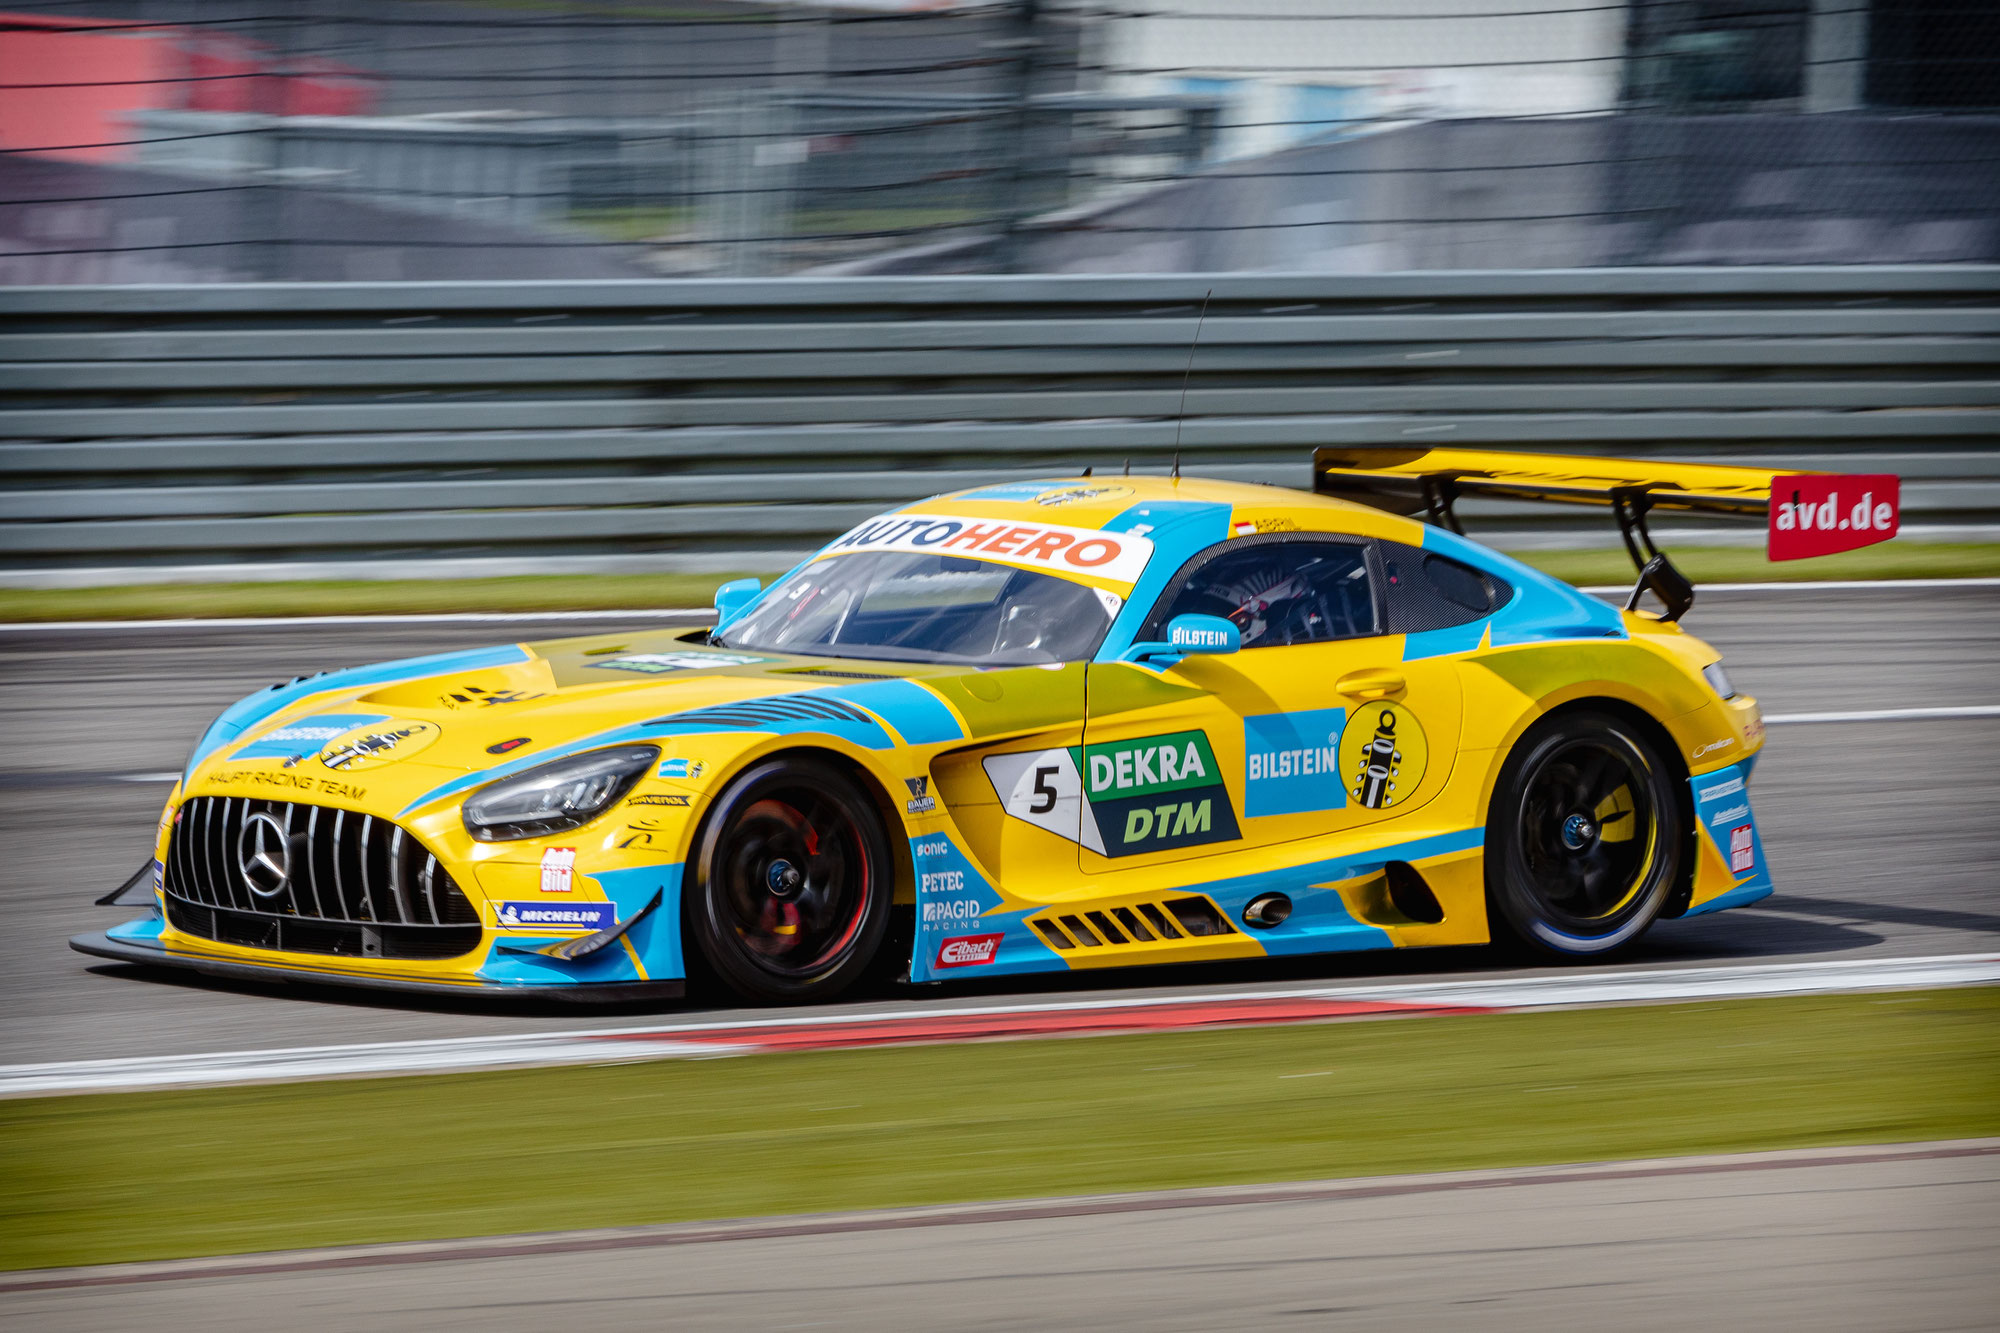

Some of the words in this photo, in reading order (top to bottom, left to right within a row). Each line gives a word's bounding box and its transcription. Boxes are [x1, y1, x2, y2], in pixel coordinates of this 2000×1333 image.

[1776, 491, 1893, 530] avd.de
[832, 521, 1122, 567] AUTOHERO
[1172, 626, 1228, 646] BILSTEIN
[1089, 741, 1206, 792] DEKRA
[1249, 746, 1336, 781] BILSTEIN
[252, 772, 314, 790] RACING
[317, 779, 367, 800] TEAM
[1029, 766, 1060, 815] 5
[1123, 799, 1212, 843] DTM
[921, 871, 964, 893] PETEC
[520, 909, 601, 923] MICHELIN
[937, 899, 980, 920] PAGID
[923, 920, 980, 932] RACING
[942, 939, 995, 964] Eibach
